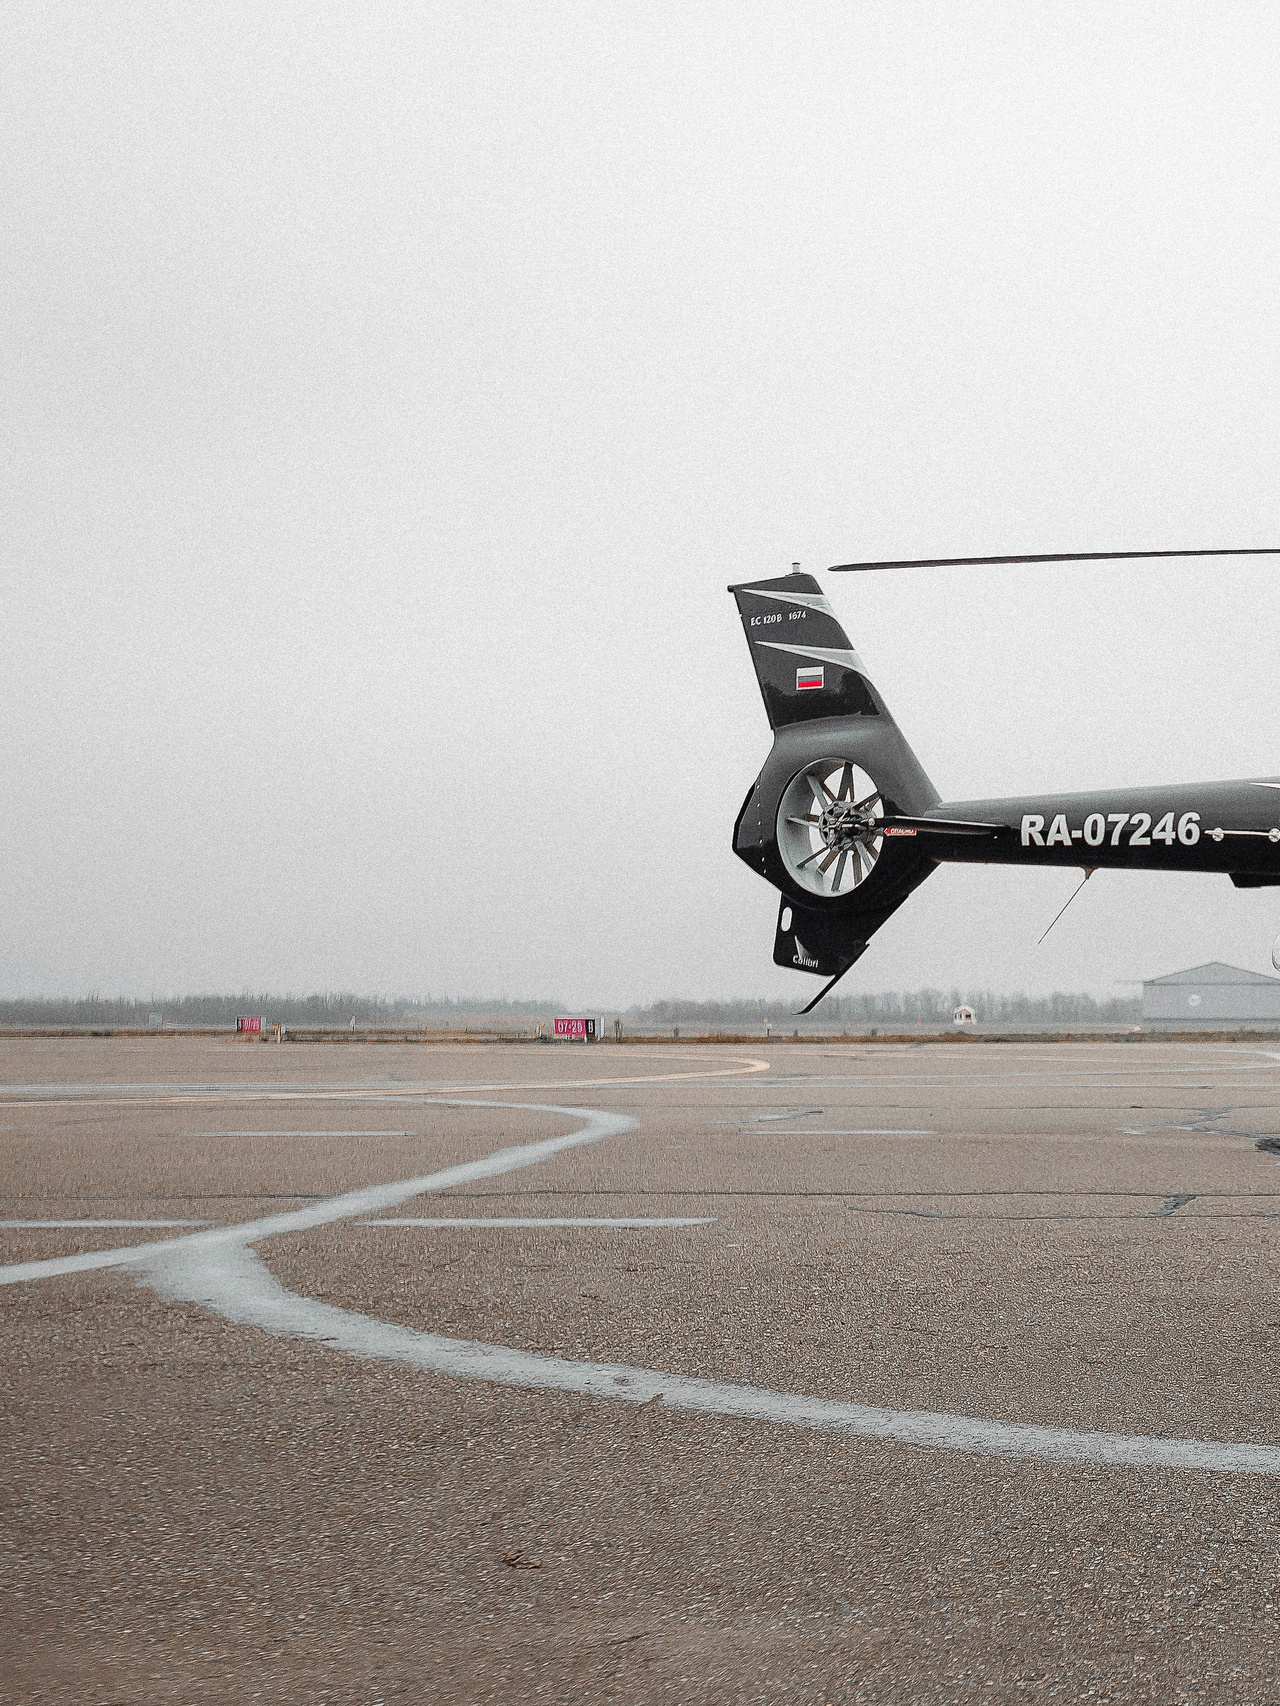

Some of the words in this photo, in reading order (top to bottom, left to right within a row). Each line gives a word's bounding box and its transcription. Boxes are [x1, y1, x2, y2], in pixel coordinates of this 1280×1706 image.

[750, 616, 762, 626] EC
[763, 613, 783, 625] 120B
[788, 610, 807, 621] 1674
[1020, 811, 1201, 847] RA-07246
